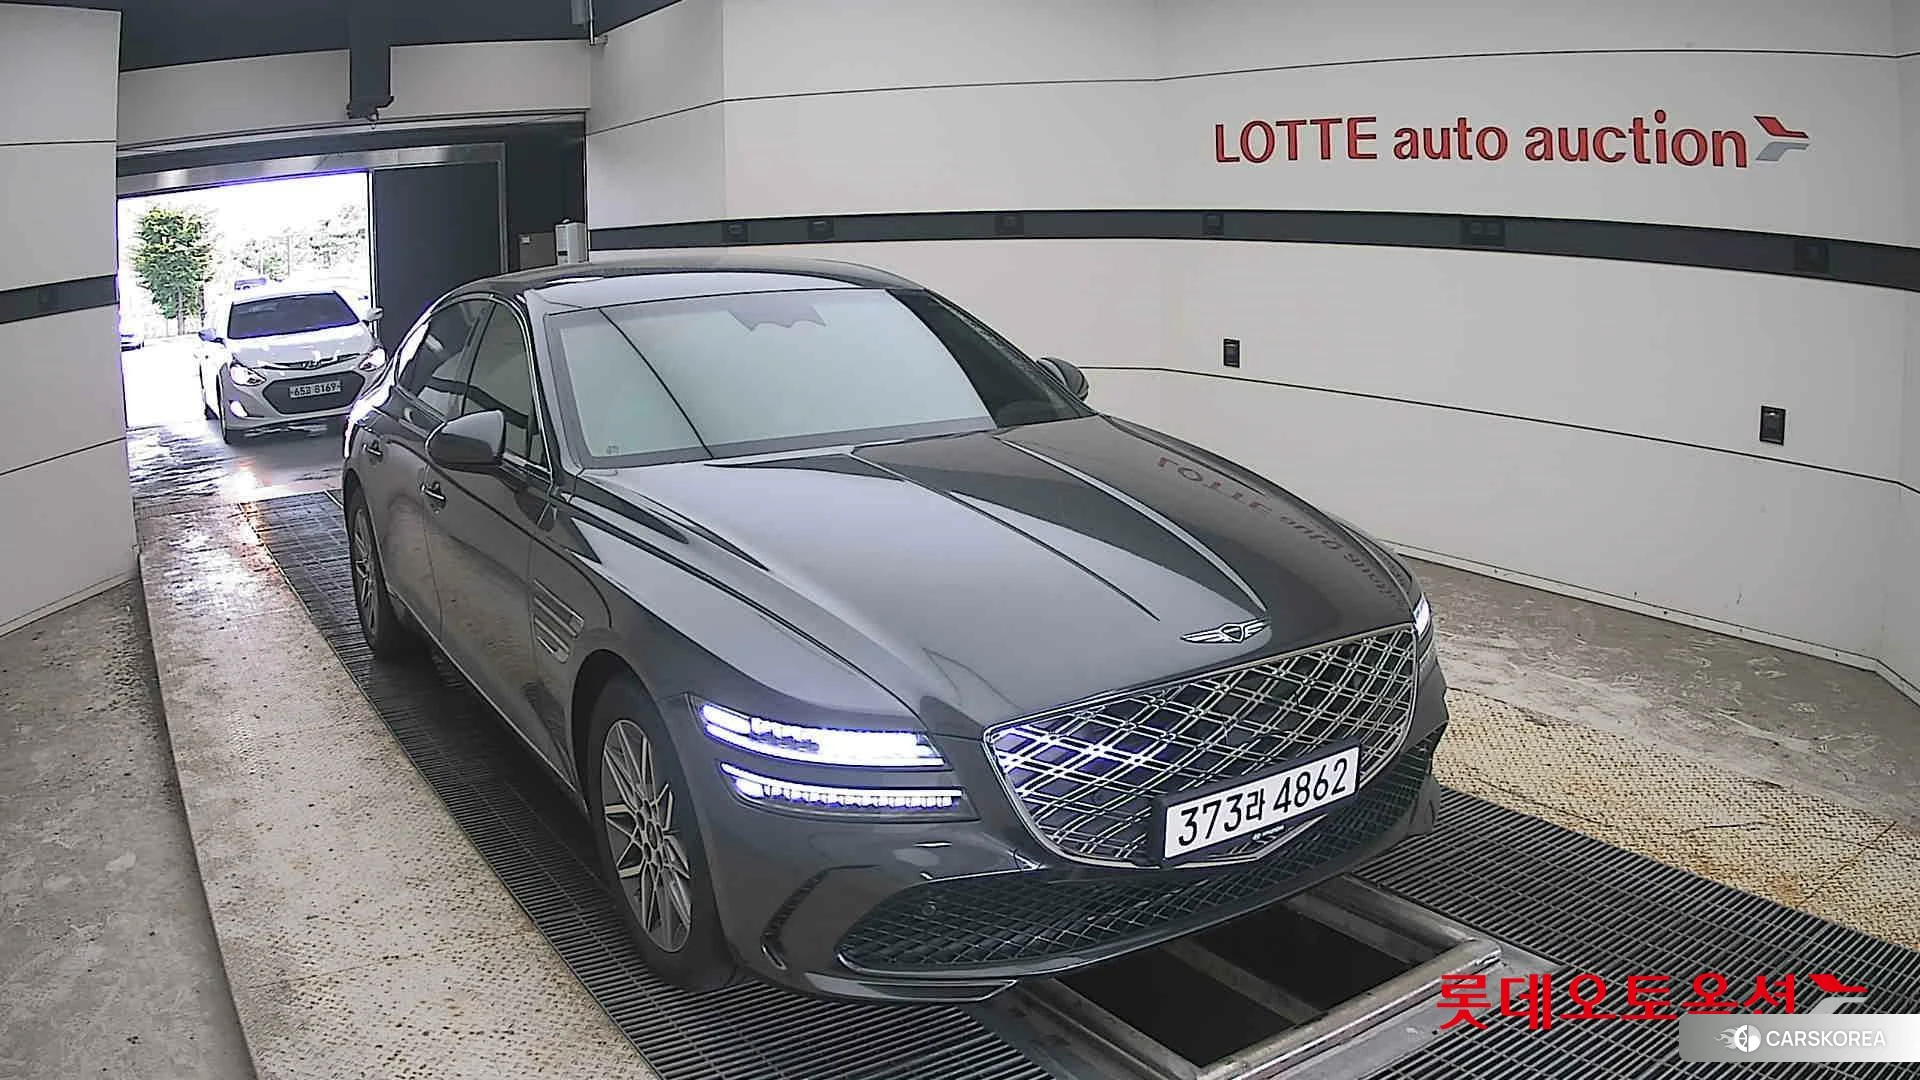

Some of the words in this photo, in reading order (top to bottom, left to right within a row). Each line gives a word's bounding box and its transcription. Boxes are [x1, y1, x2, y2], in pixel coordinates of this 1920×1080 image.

[1215, 116, 1377, 163] LOTTE
[1393, 117, 1509, 161] auto
[1524, 109, 1749, 168] auction
[1177, 788, 1266, 847] 373라
[1272, 757, 1348, 814] 4862
